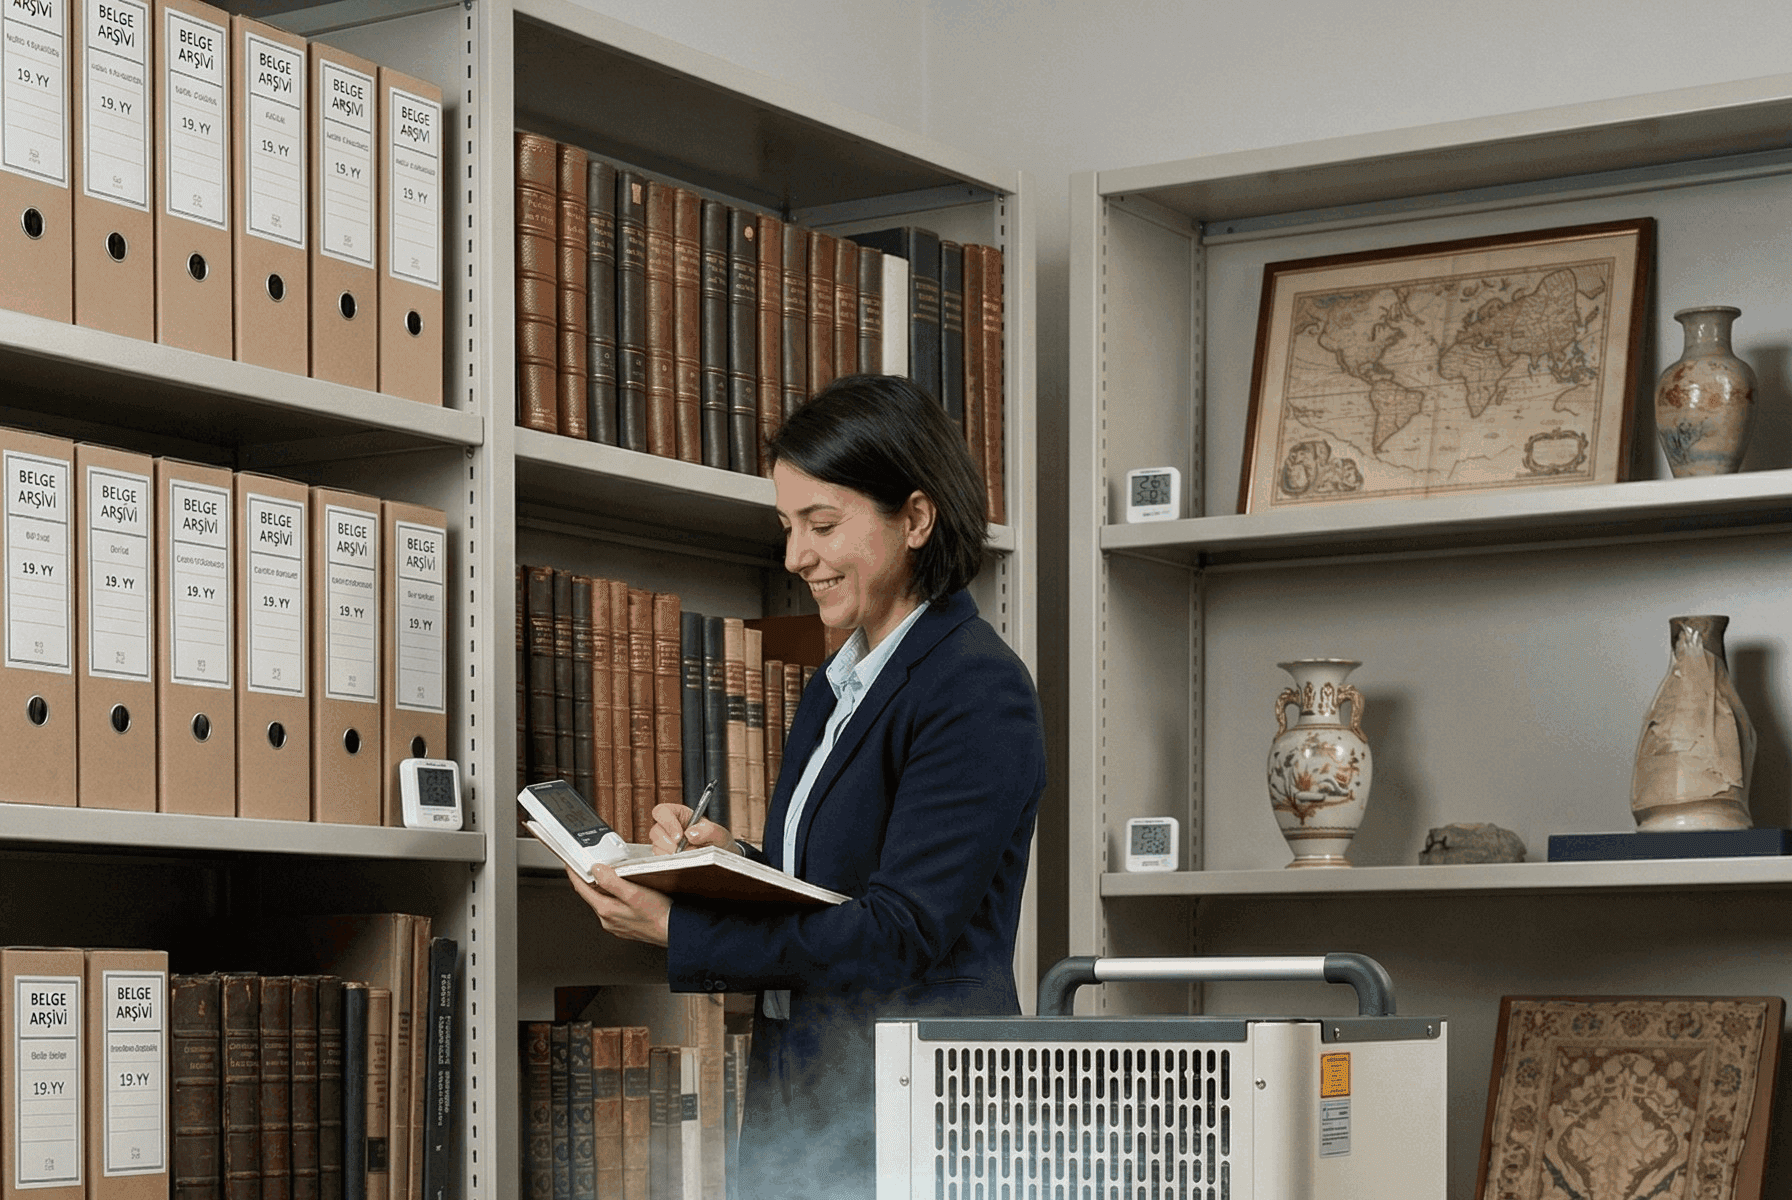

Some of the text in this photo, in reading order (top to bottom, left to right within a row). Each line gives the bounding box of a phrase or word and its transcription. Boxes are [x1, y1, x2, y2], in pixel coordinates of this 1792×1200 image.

[99, 4, 134, 28] BELGE
[180, 29, 213, 52] BELGE
[259, 52, 291, 75] BELGE
[17, 68, 50, 88] 19. YY
[333, 78, 363, 100] BELGE
[101, 96, 132, 115] 19. YY
[401, 106, 430, 127] BELGE
[182, 117, 211, 135] 19. YY
[261, 139, 290, 157] 19. YY
[350, 167, 361, 179] YY
[417, 191, 428, 204] YY
[19, 469, 56, 489] BELGE
[18, 490, 56, 509] ARŞİVİ
[102, 485, 137, 503] BELGE
[184, 498, 217, 516] BELGE
[260, 511, 292, 529] BELGE
[337, 522, 367, 539] BELGE
[407, 537, 435, 554] BELGE
[22, 562, 54, 577] 19. YY
[105, 575, 135, 590] 19. YY
[187, 585, 215, 600] 19. YY
[263, 595, 290, 609] 19. YY
[339, 605, 364, 619] 19. YY
[31, 992, 67, 1006] BELGE
[117, 987, 152, 1000] BELGE
[29, 1009, 67, 1029] ARŞİVİ
[116, 1002, 152, 1022] ARŞİVİ
